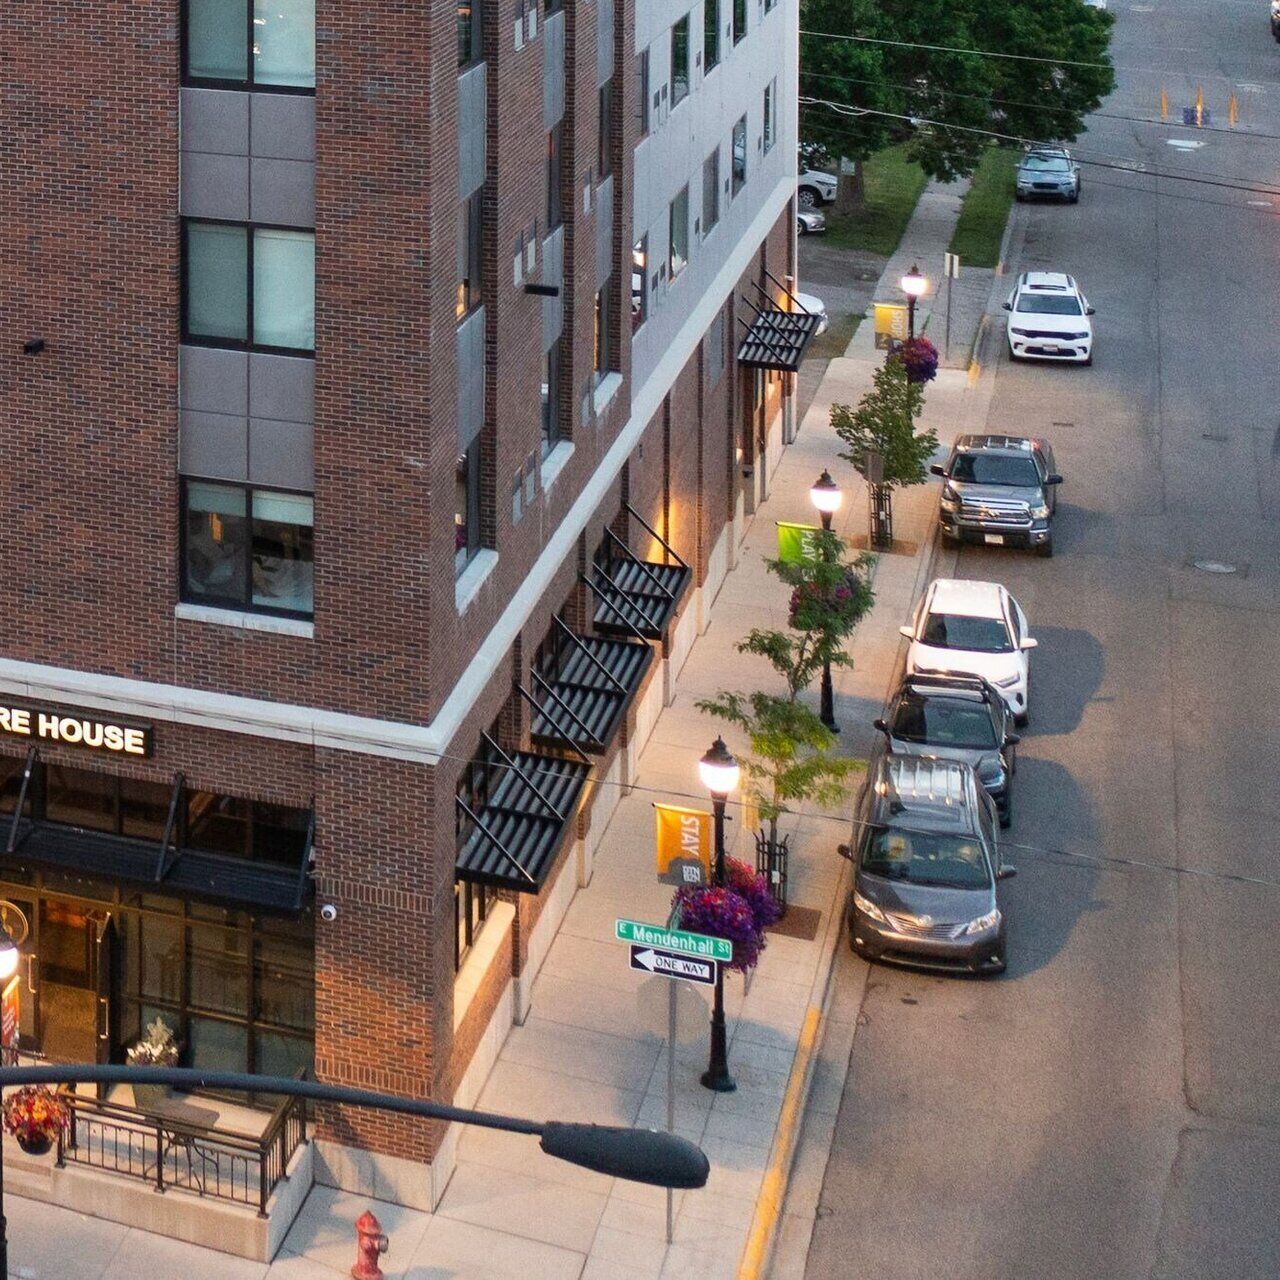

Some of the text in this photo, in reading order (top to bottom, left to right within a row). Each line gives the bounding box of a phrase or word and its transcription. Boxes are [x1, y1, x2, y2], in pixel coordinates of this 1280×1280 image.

[38, 713, 145, 755] HOUSE
[681, 814, 700, 857] STAY
[619, 923, 729, 955] E Mendenhall St
[655, 956, 706, 976] ONE WAY
